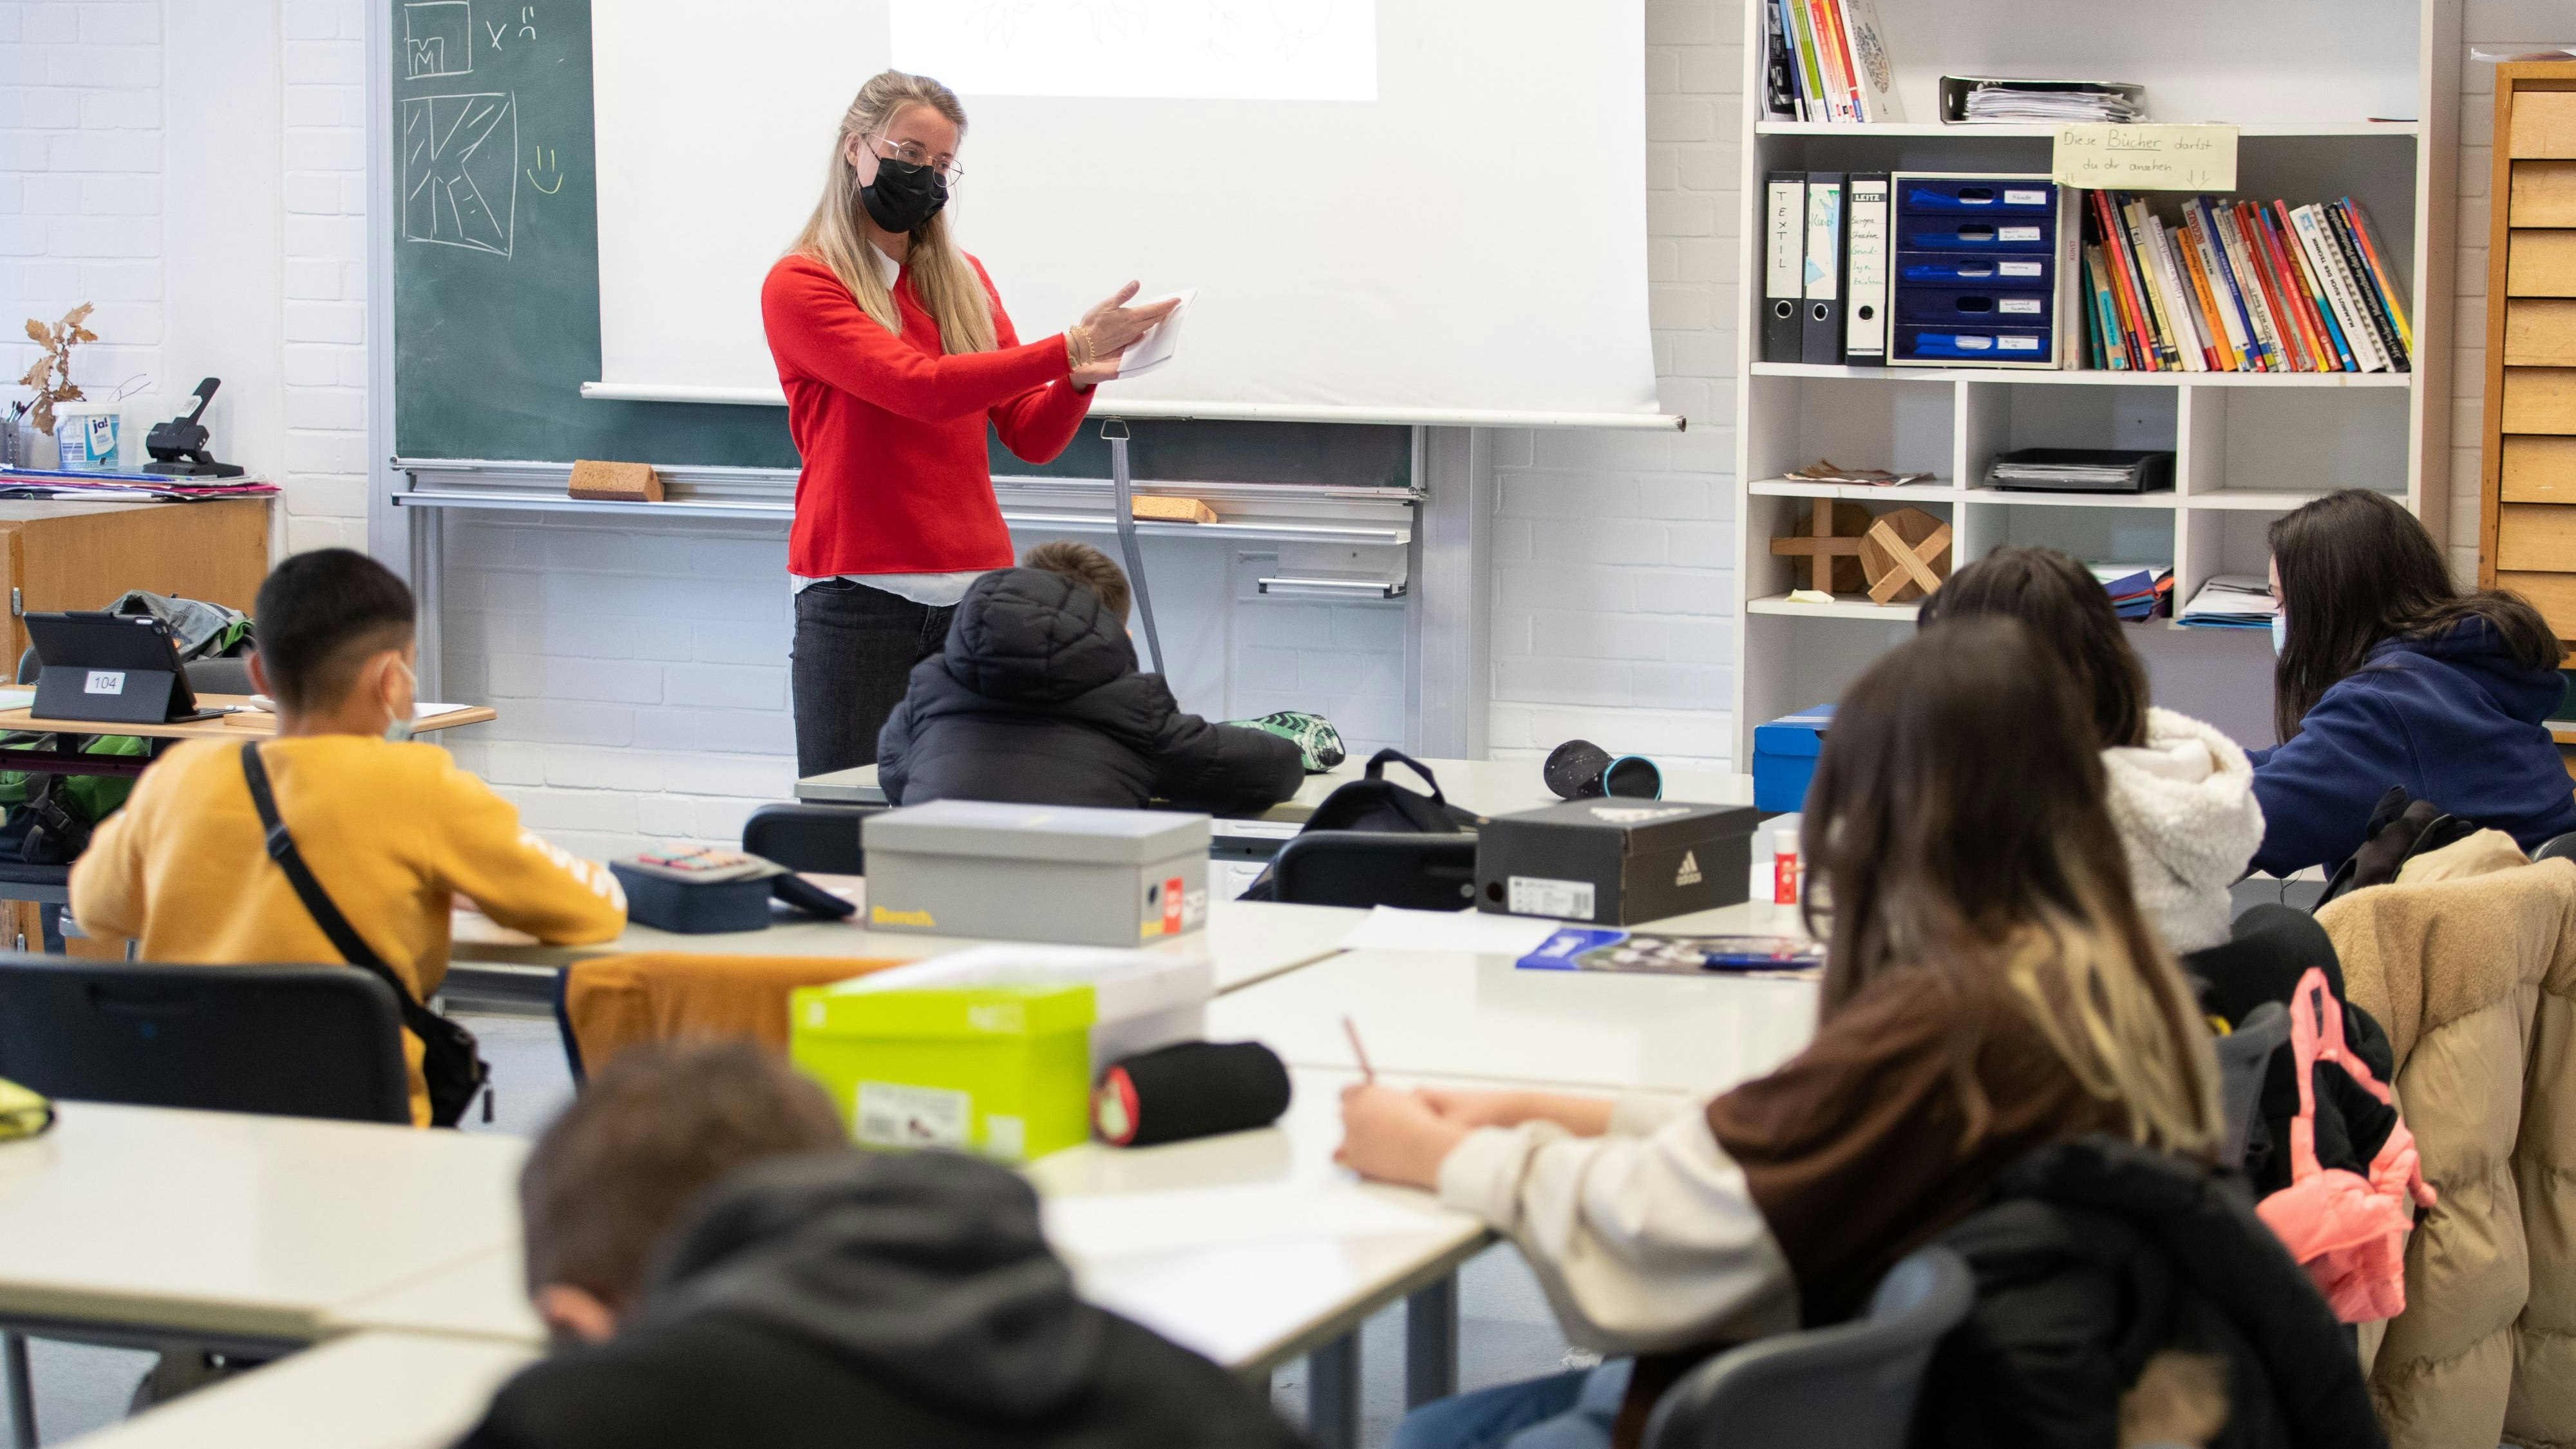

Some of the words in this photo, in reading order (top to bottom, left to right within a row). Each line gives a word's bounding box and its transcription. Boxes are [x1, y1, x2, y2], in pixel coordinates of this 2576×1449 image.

[2064, 131, 2096, 146] Diese
[2108, 129, 2163, 148] Bücher
[2174, 136, 2213, 150] darfst
[2083, 158, 2098, 170] du
[2104, 158, 2120, 170] dir
[1777, 191, 1787, 268] TEXTIL
[2325, 207, 2355, 257] Photographie
[2311, 236, 2327, 263] TECHNIK
[2152, 221, 2183, 299] Glückwunschkarten
[2347, 254, 2360, 269] der
[2323, 265, 2333, 278] DER
[2146, 278, 2157, 298] Musik
[2354, 267, 2382, 316] Meisterschule
[2153, 299, 2161, 310] und
[2329, 278, 2355, 328] MAMMUT-BUCH
[2157, 312, 2168, 330] Kunst
[2257, 309, 2267, 323] WAS
[2262, 324, 2273, 341] MICH
[2388, 343, 2401, 360] John
[92, 417, 108, 433] ja!
[95, 677, 117, 689] 104
[1676, 872, 1702, 886] adidas
